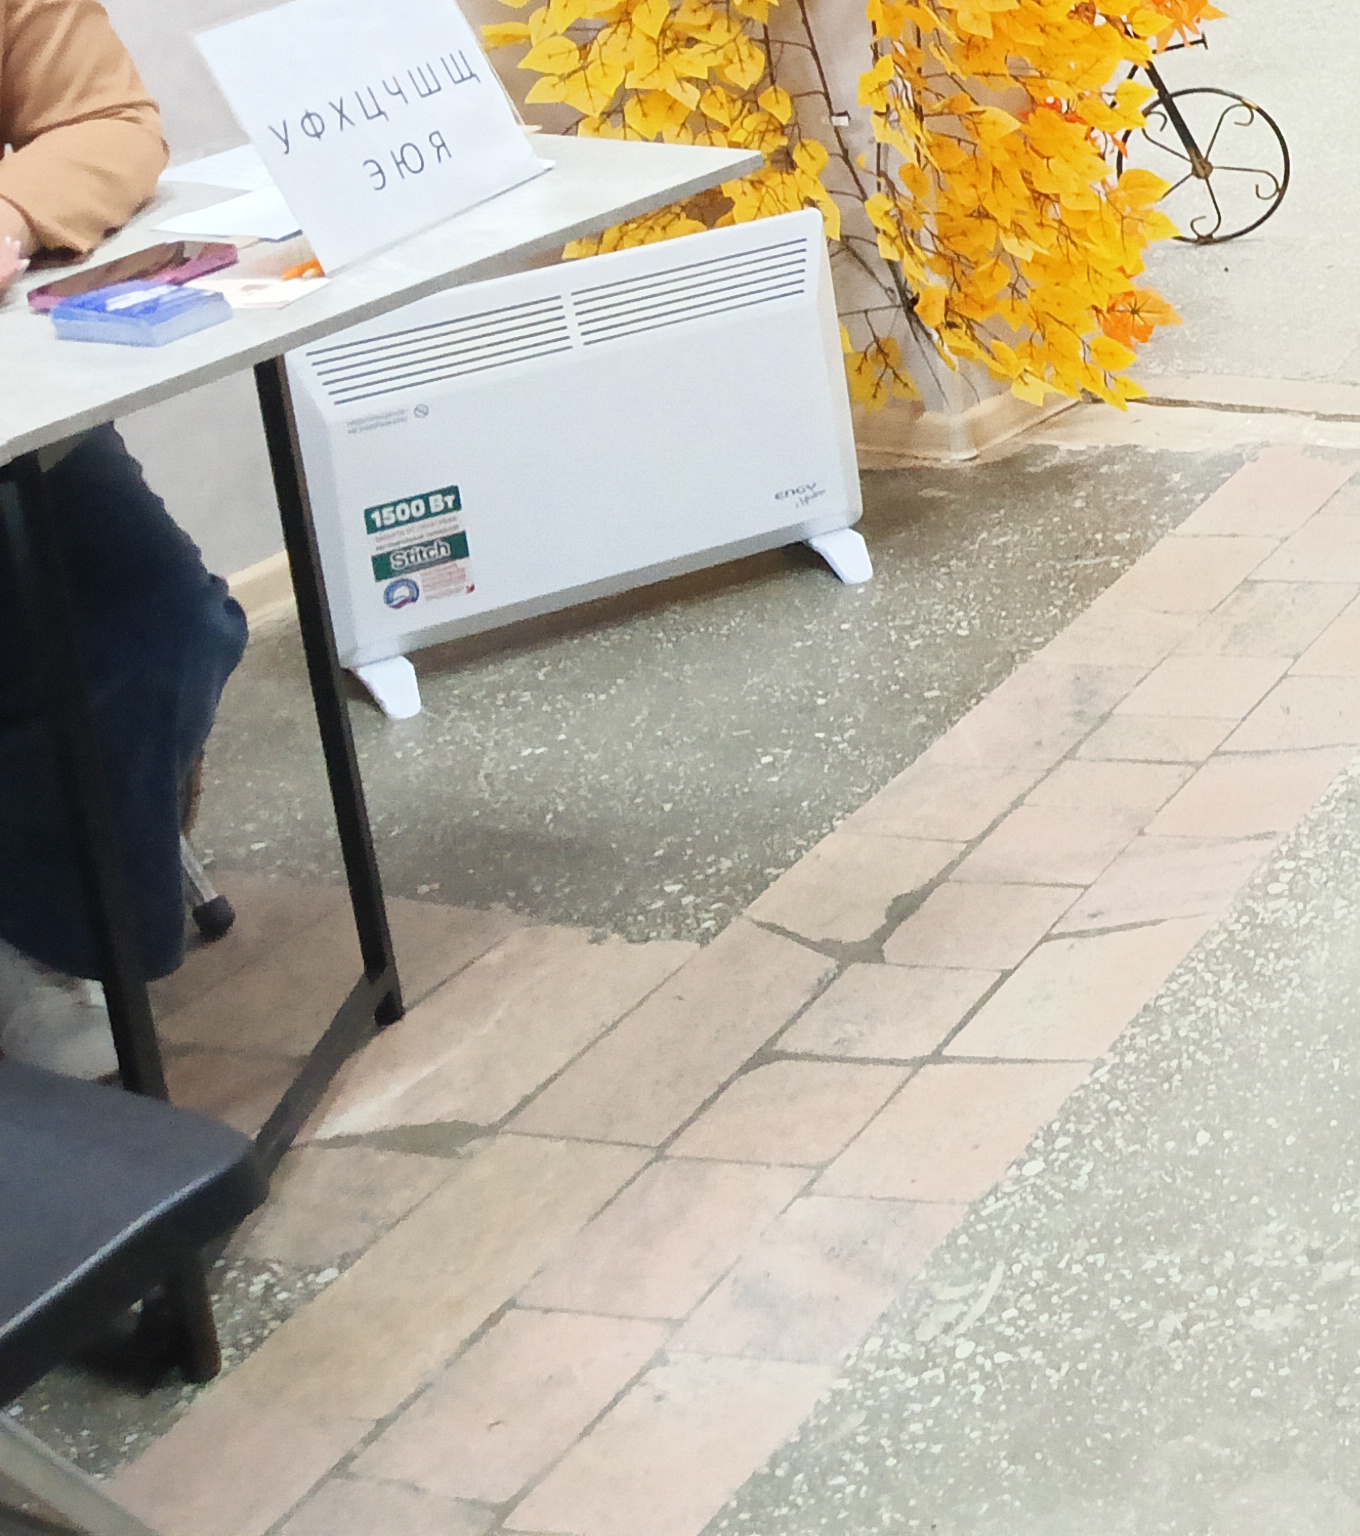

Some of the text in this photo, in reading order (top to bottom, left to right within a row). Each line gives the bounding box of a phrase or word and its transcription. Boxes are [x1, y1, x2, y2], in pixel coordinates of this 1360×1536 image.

[371, 493, 456, 529] 1500 Вт
[391, 539, 451, 570] Stitch
